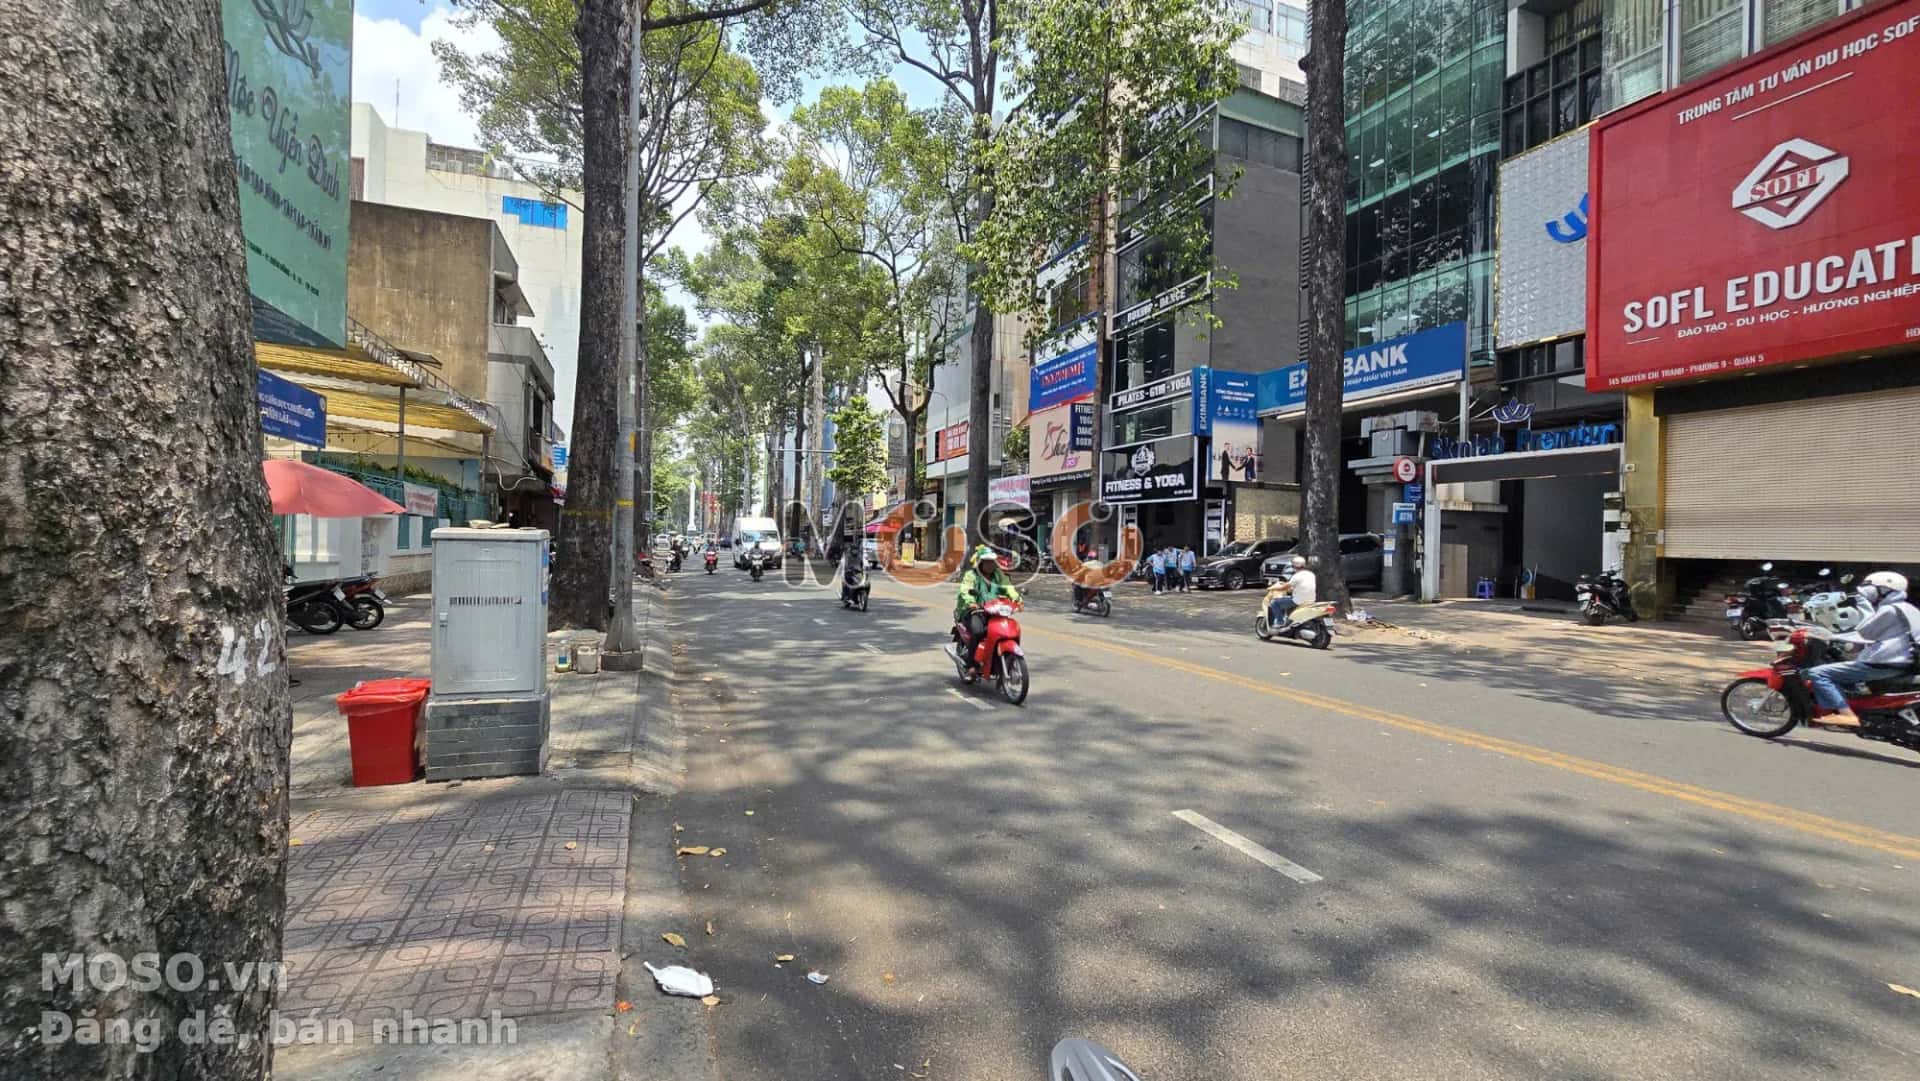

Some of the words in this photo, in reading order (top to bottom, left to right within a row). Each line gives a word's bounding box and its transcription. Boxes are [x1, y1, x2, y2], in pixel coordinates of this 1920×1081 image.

[1677, 97, 1722, 125] TRUNG
[1725, 83, 1755, 106] TÂM
[1758, 73, 1780, 94] TƯ
[1781, 59, 1812, 84] VẤN
[1815, 49, 1839, 71] DU
[1842, 33, 1879, 60] HỌC
[1750, 166, 1825, 202] SOFL
[1623, 286, 1714, 334] SOFL
[1703, 321, 1728, 335] TẠO
[1736, 316, 1756, 328] DU
[1759, 308, 1790, 324] HỌC
[1802, 295, 1860, 315] HƯỚNG
[1288, 342, 1408, 390] EXBANK
[1117, 390, 1145, 407] PILATES
[1171, 375, 1192, 391] YOGA
[1199, 373, 1208, 431] EXIMBANK
[1105, 478, 1142, 493] FITNESS
[1143, 476, 1153, 490] &
[1154, 472, 1186, 488] YOGA
